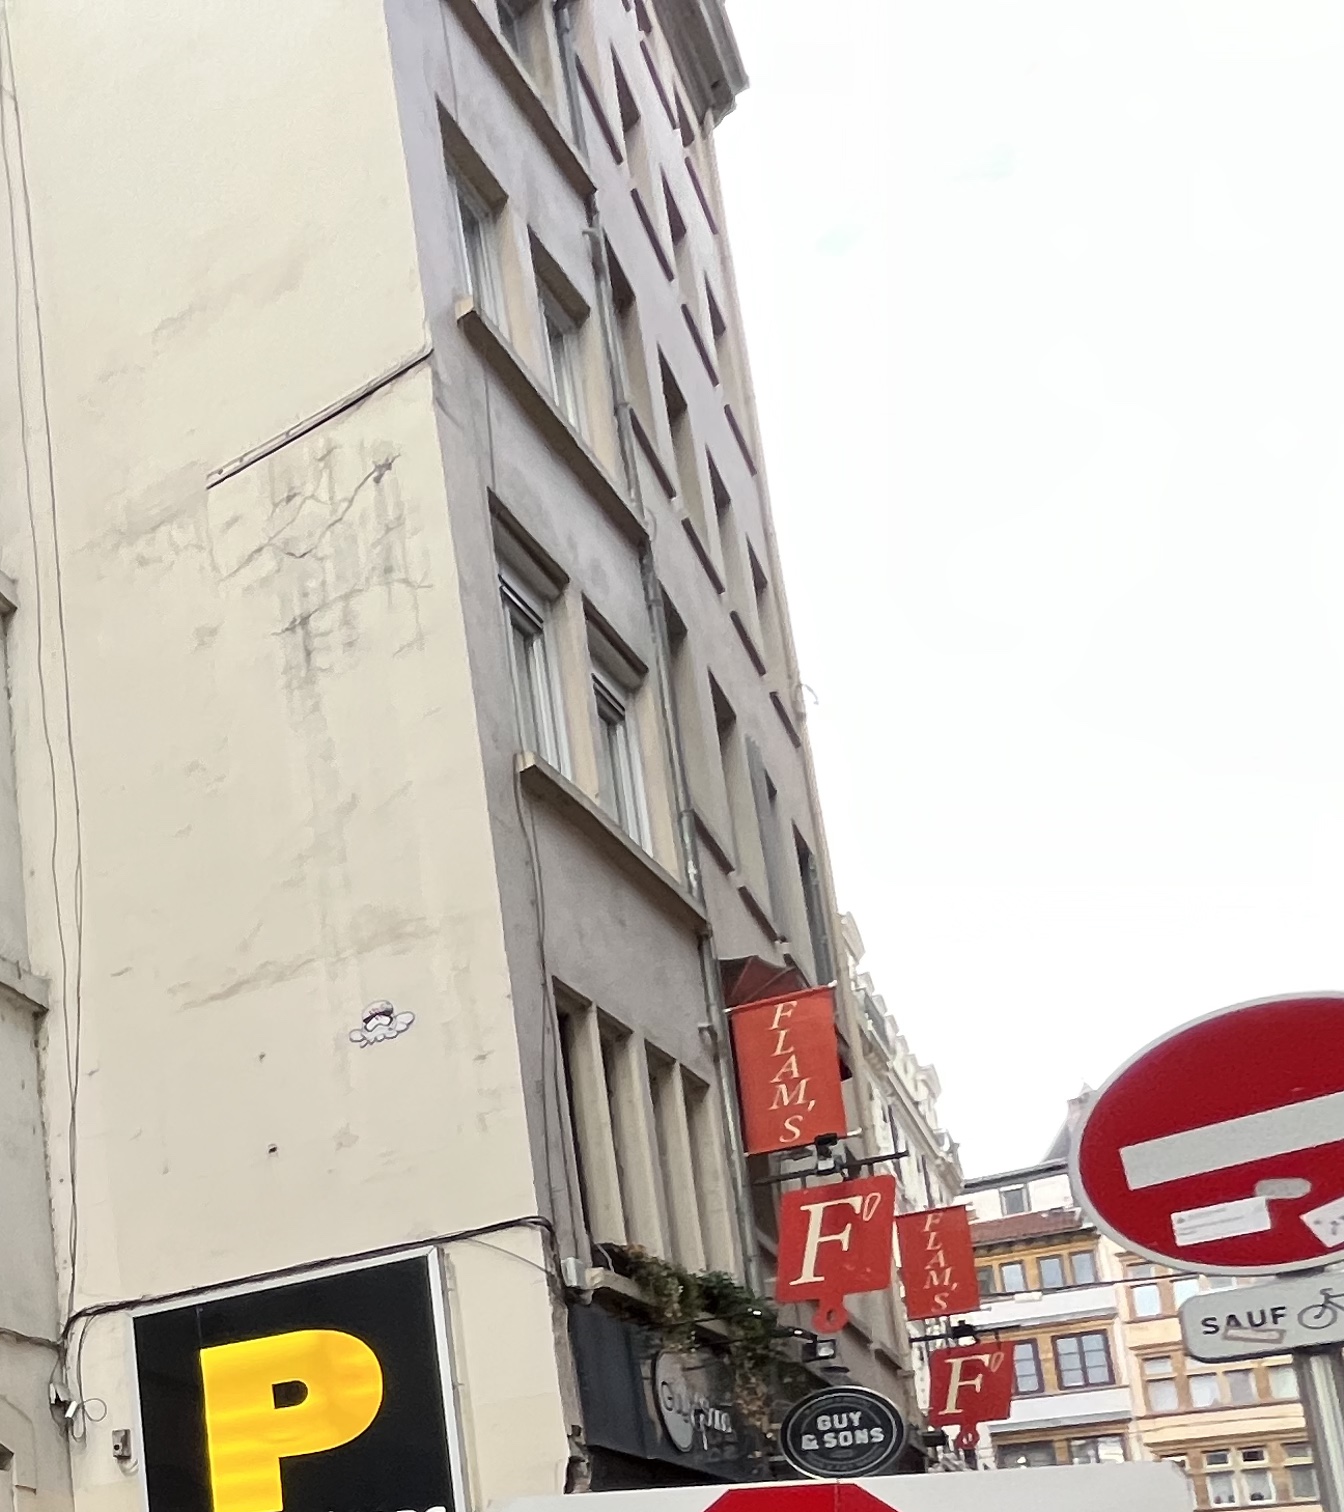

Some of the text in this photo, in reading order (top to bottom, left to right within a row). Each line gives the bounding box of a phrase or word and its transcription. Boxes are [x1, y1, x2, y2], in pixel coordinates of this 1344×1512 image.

[1201, 1306, 1287, 1335] SAUF
[817, 1411, 862, 1431] GUY
[823, 1427, 885, 1449] SONS
